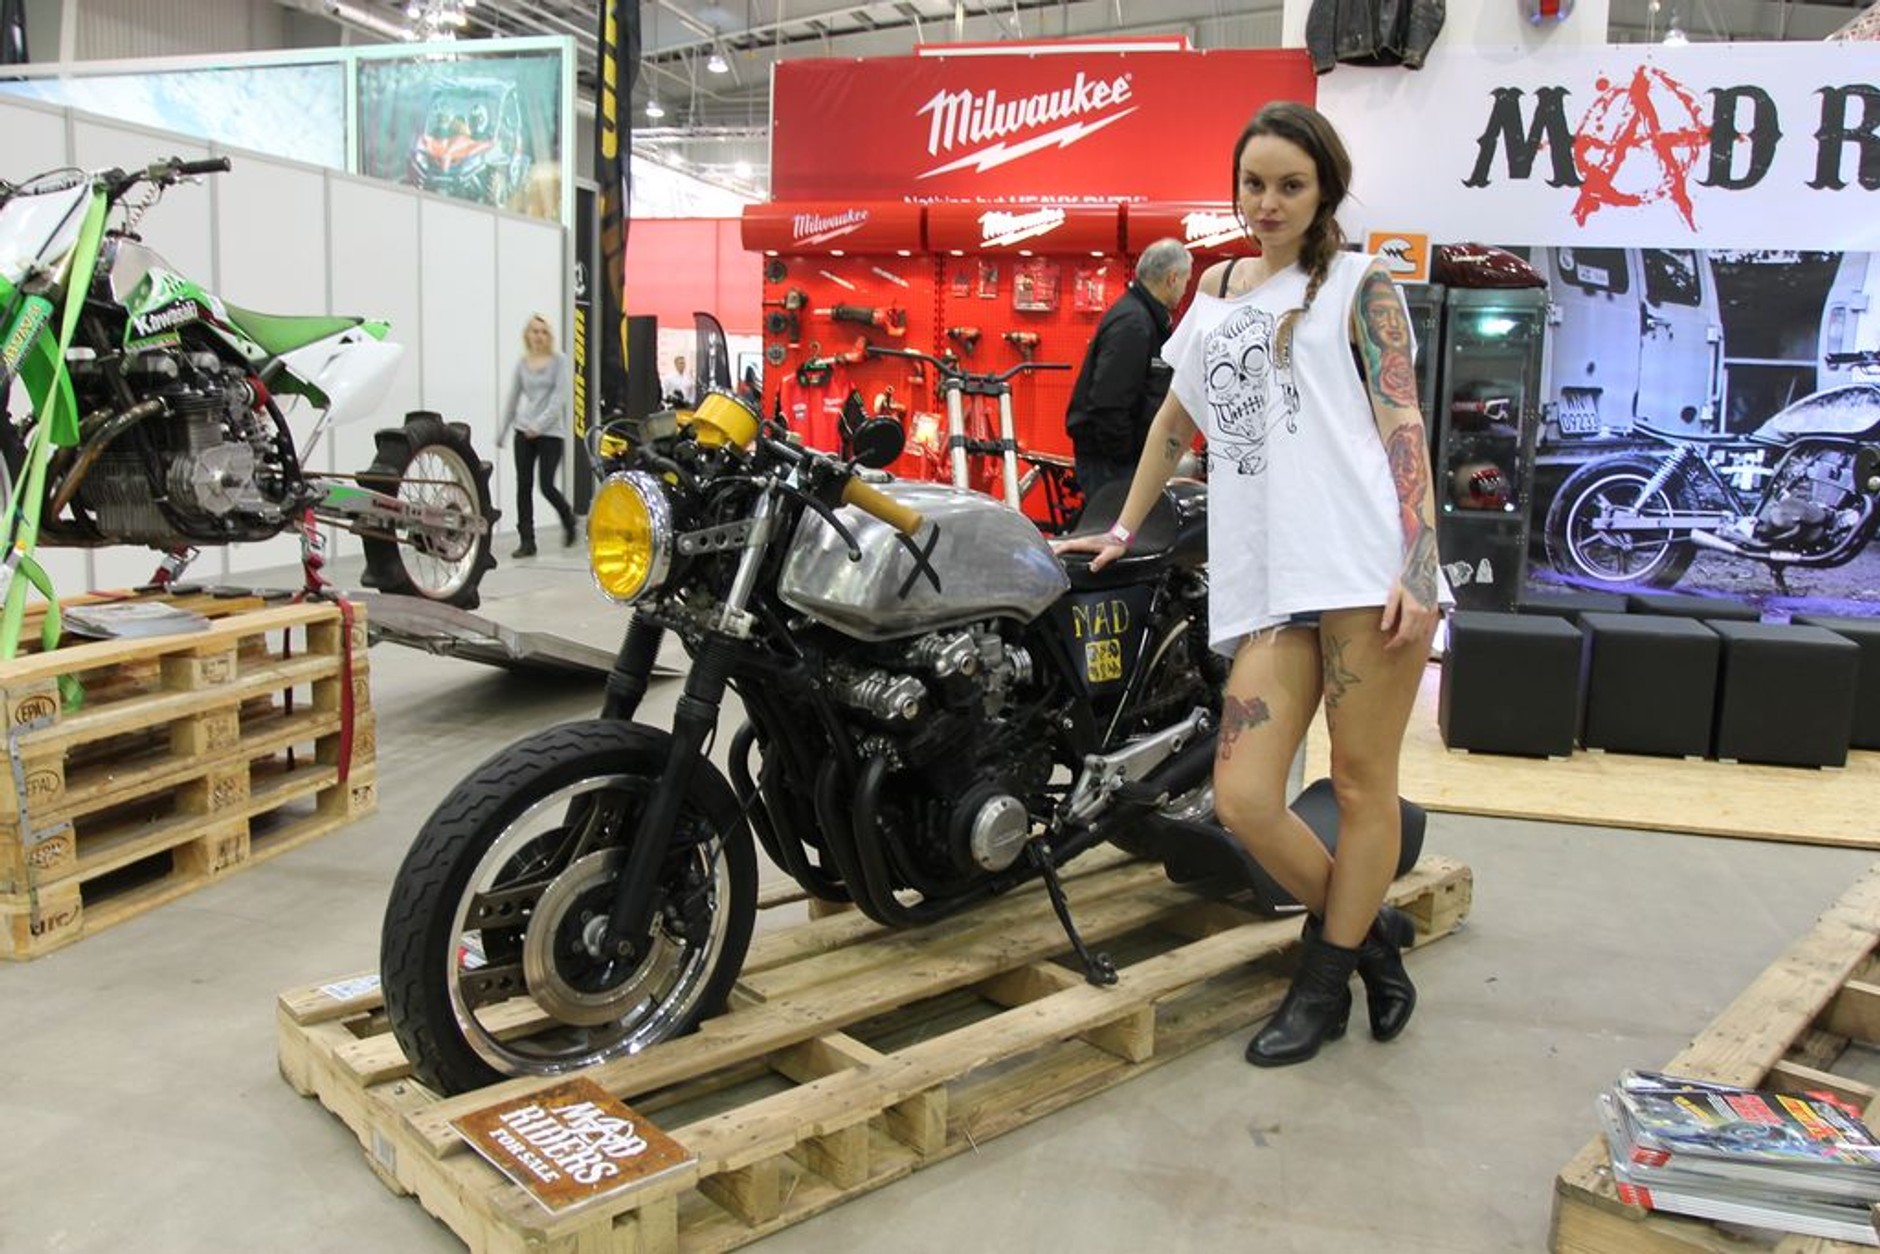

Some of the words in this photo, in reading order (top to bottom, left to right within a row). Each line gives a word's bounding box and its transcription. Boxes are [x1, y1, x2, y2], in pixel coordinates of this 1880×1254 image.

[916, 72, 1133, 157] Milwaukee
[1461, 65, 1783, 233] MAD
[793, 208, 869, 239] Milwaukee
[1072, 600, 1129, 638] MAD
[489, 1128, 525, 1158] FOR
[519, 1151, 561, 1183] SALE
[500, 1105, 618, 1183] RIDERS
